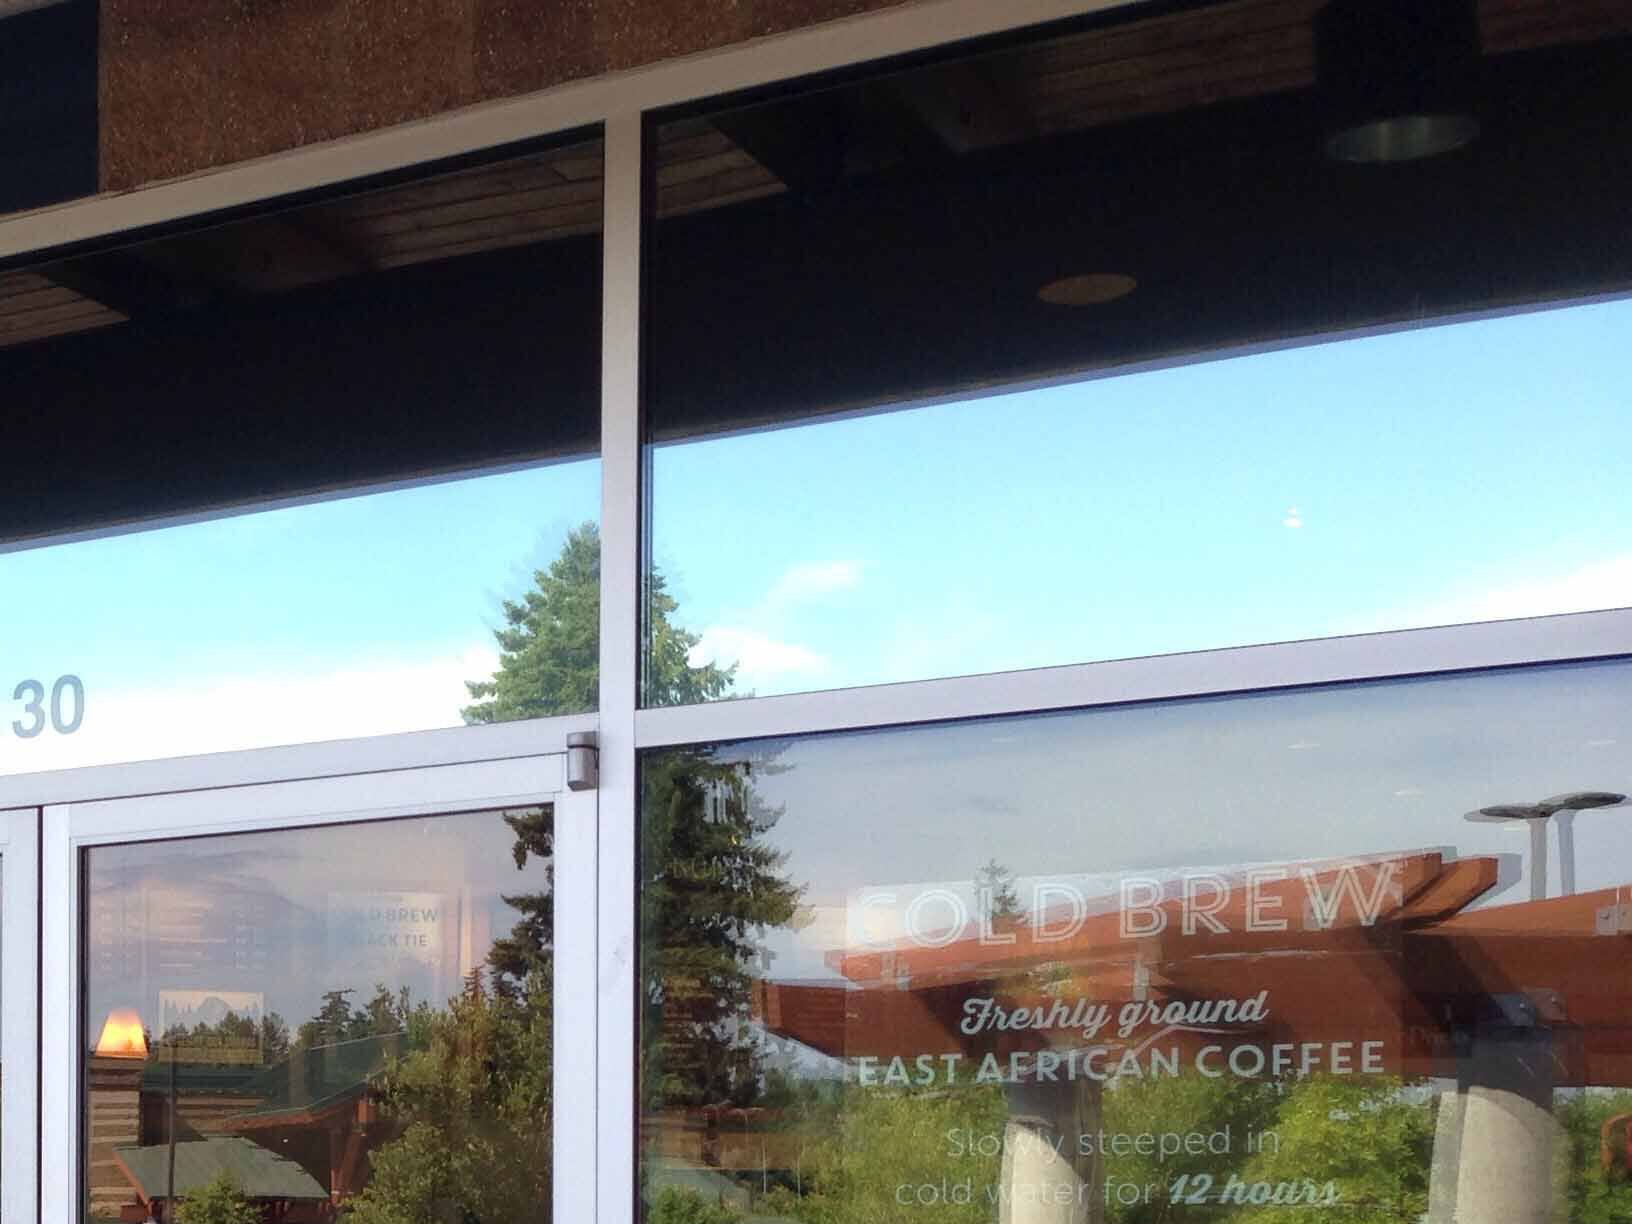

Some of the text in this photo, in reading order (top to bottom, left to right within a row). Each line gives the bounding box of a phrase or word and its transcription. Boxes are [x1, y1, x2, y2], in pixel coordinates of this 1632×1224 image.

[855, 861, 1394, 949] COLD BREW
[960, 991, 1270, 1041] Freshly ground
[857, 1040, 1386, 1088] EAST AFRICAN COFFEE
[947, 1125, 1280, 1164] Slowly steeped in
[895, 1173, 1344, 1207] cold water for 12 hours
